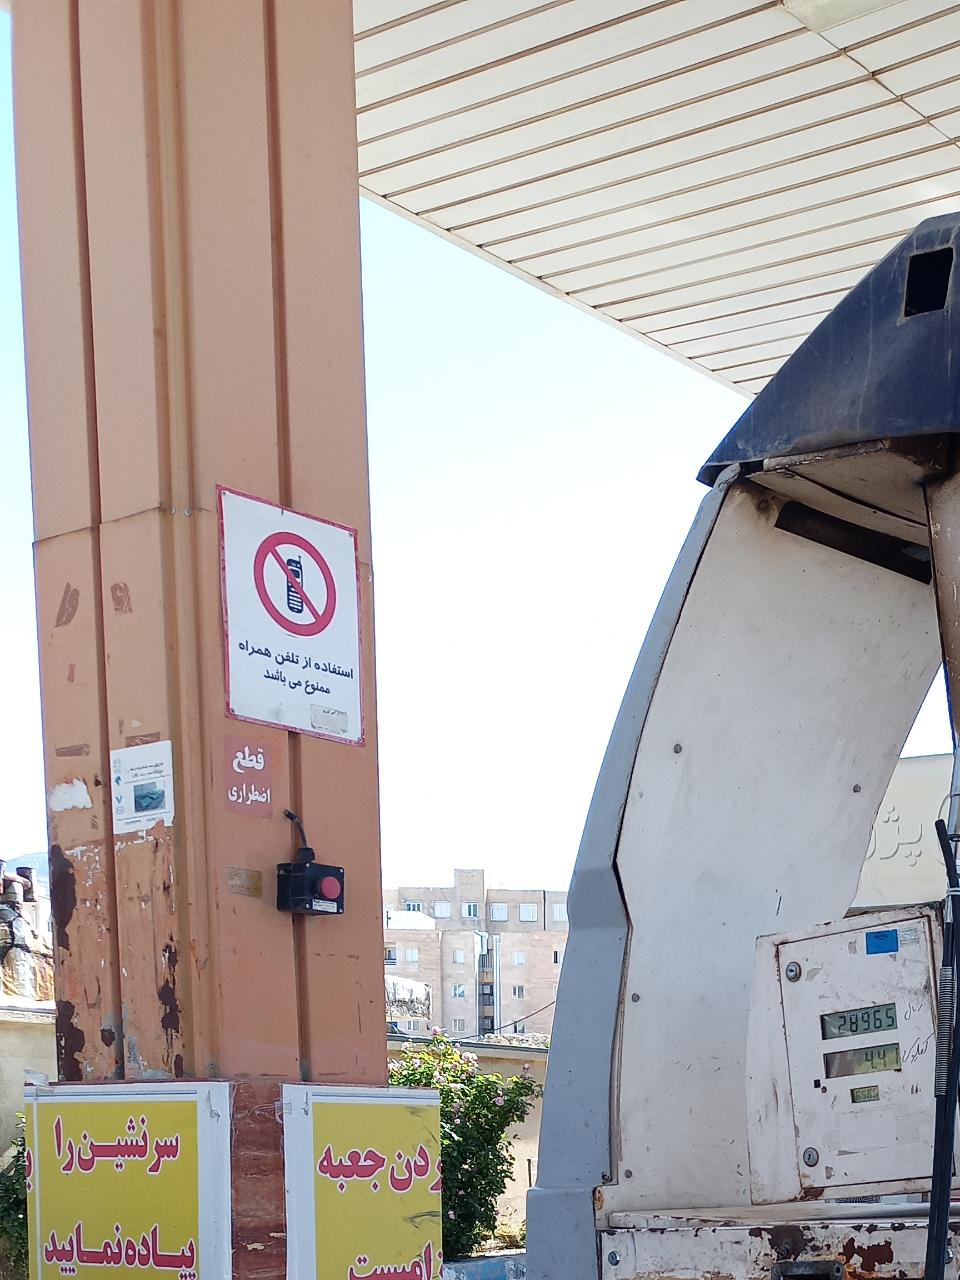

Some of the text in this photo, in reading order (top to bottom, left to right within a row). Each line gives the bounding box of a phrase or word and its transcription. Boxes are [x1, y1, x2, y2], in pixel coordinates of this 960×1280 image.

[238, 640, 354, 679] استفاده از تلفن همراه
[263, 669, 331, 694] ممنوع می باشد
[232, 746, 265, 773] قطع
[228, 782, 271, 805] اضطراری
[838, 1008, 895, 1033] 28965
[53, 1115, 75, 1173] را
[77, 1115, 180, 1173] سرنشین
[317, 1144, 442, 1193] ردن جعبه
[44, 1221, 123, 1275] نمایید
